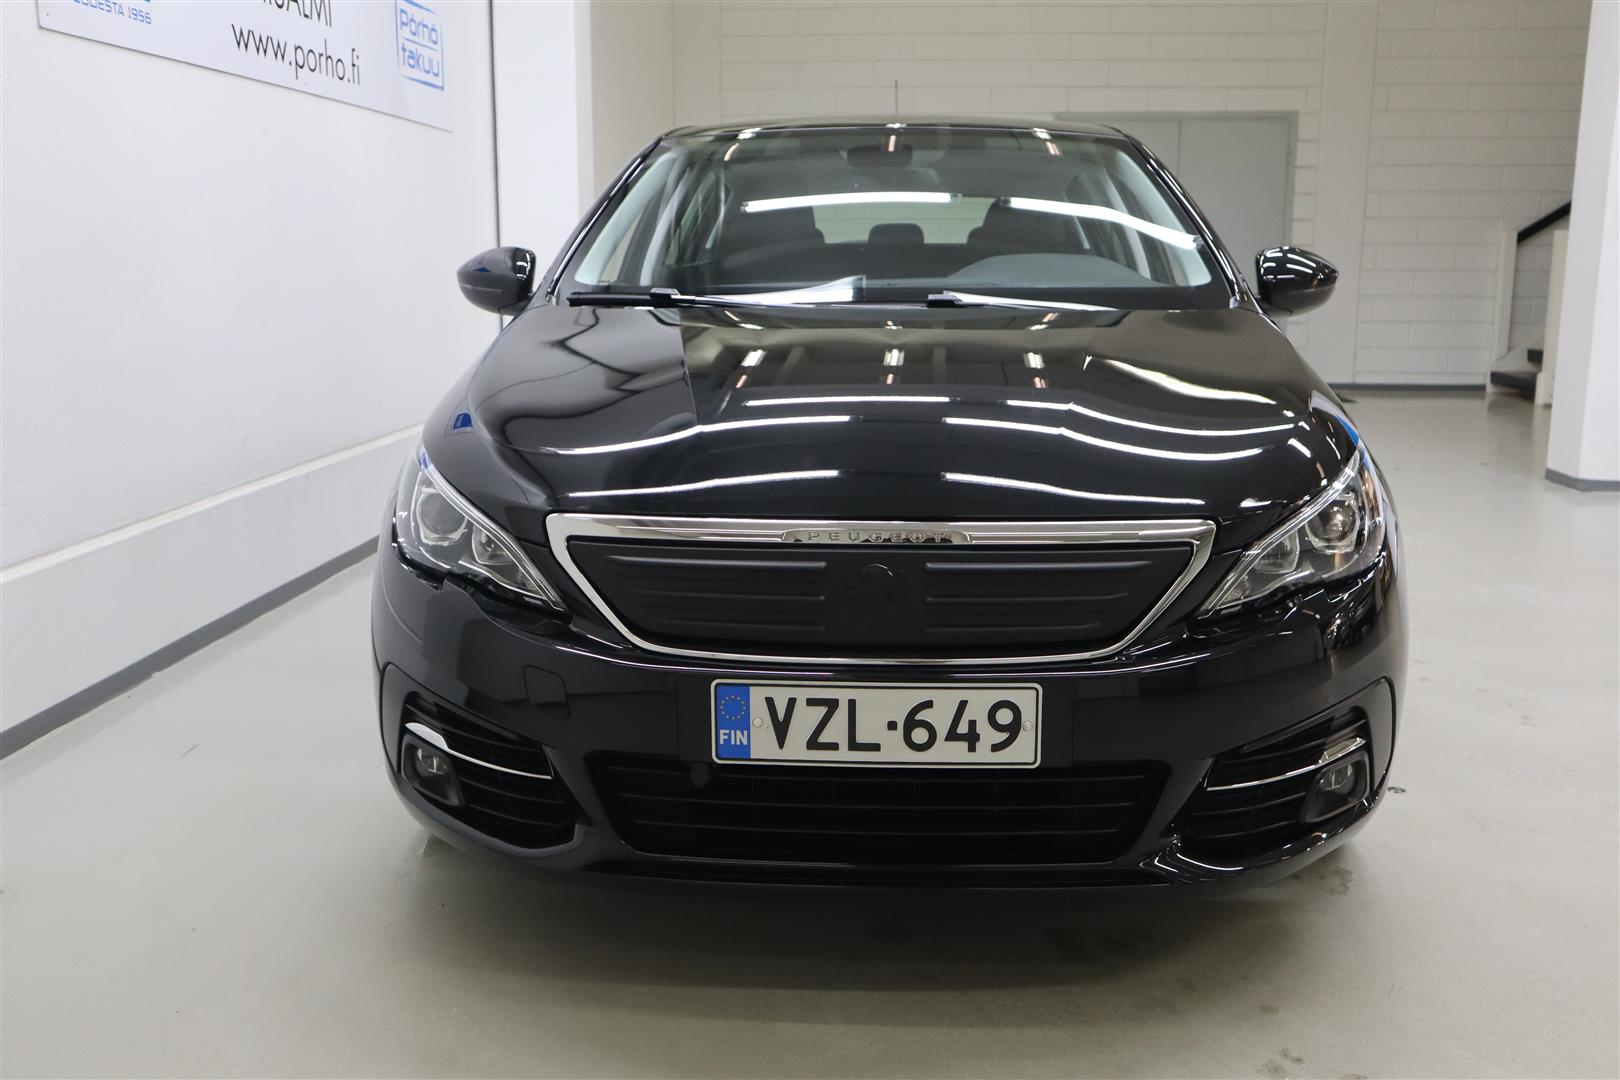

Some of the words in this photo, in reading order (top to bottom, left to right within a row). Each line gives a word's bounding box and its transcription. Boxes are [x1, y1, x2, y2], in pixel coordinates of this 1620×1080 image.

[128, 6, 152, 24] 1956
[231, 23, 360, 85] www.porho.fi
[401, 42, 440, 77] takuu
[807, 530, 953, 543] PEUGEOT
[719, 729, 748, 745] FIN
